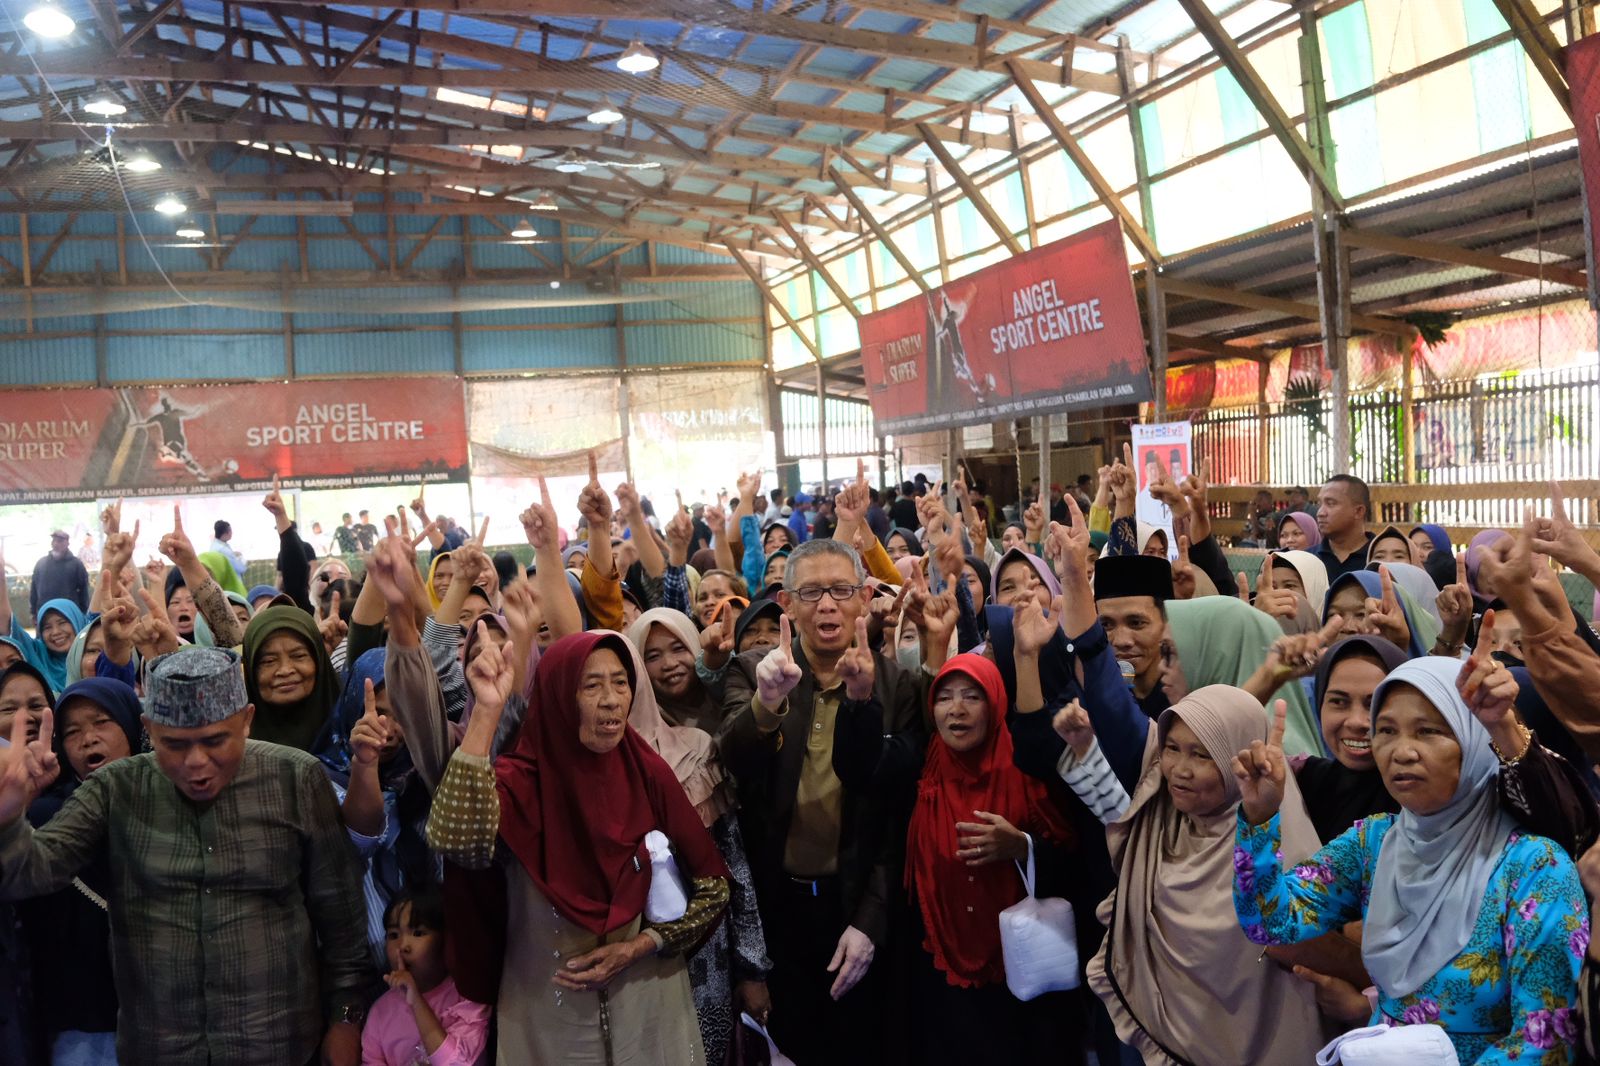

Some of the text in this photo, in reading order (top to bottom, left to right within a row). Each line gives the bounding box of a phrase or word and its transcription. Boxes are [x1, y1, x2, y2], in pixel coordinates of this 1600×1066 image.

[1013, 279, 1064, 319] ANGEL
[1037, 298, 1104, 342] CENTRE
[296, 403, 376, 424] ANGEL
[246, 420, 425, 446] SPORT CENTRE
[0, 441, 68, 461] SUPER
[137, 486, 187, 496] SERANGAN
[234, 480, 281, 491] IMPOTENI
[282, 479, 302, 489] DAN
[304, 477, 351, 488] GANGGUAN
[353, 474, 402, 485] KEHAMILAN
[403, 473, 421, 482] DAN
